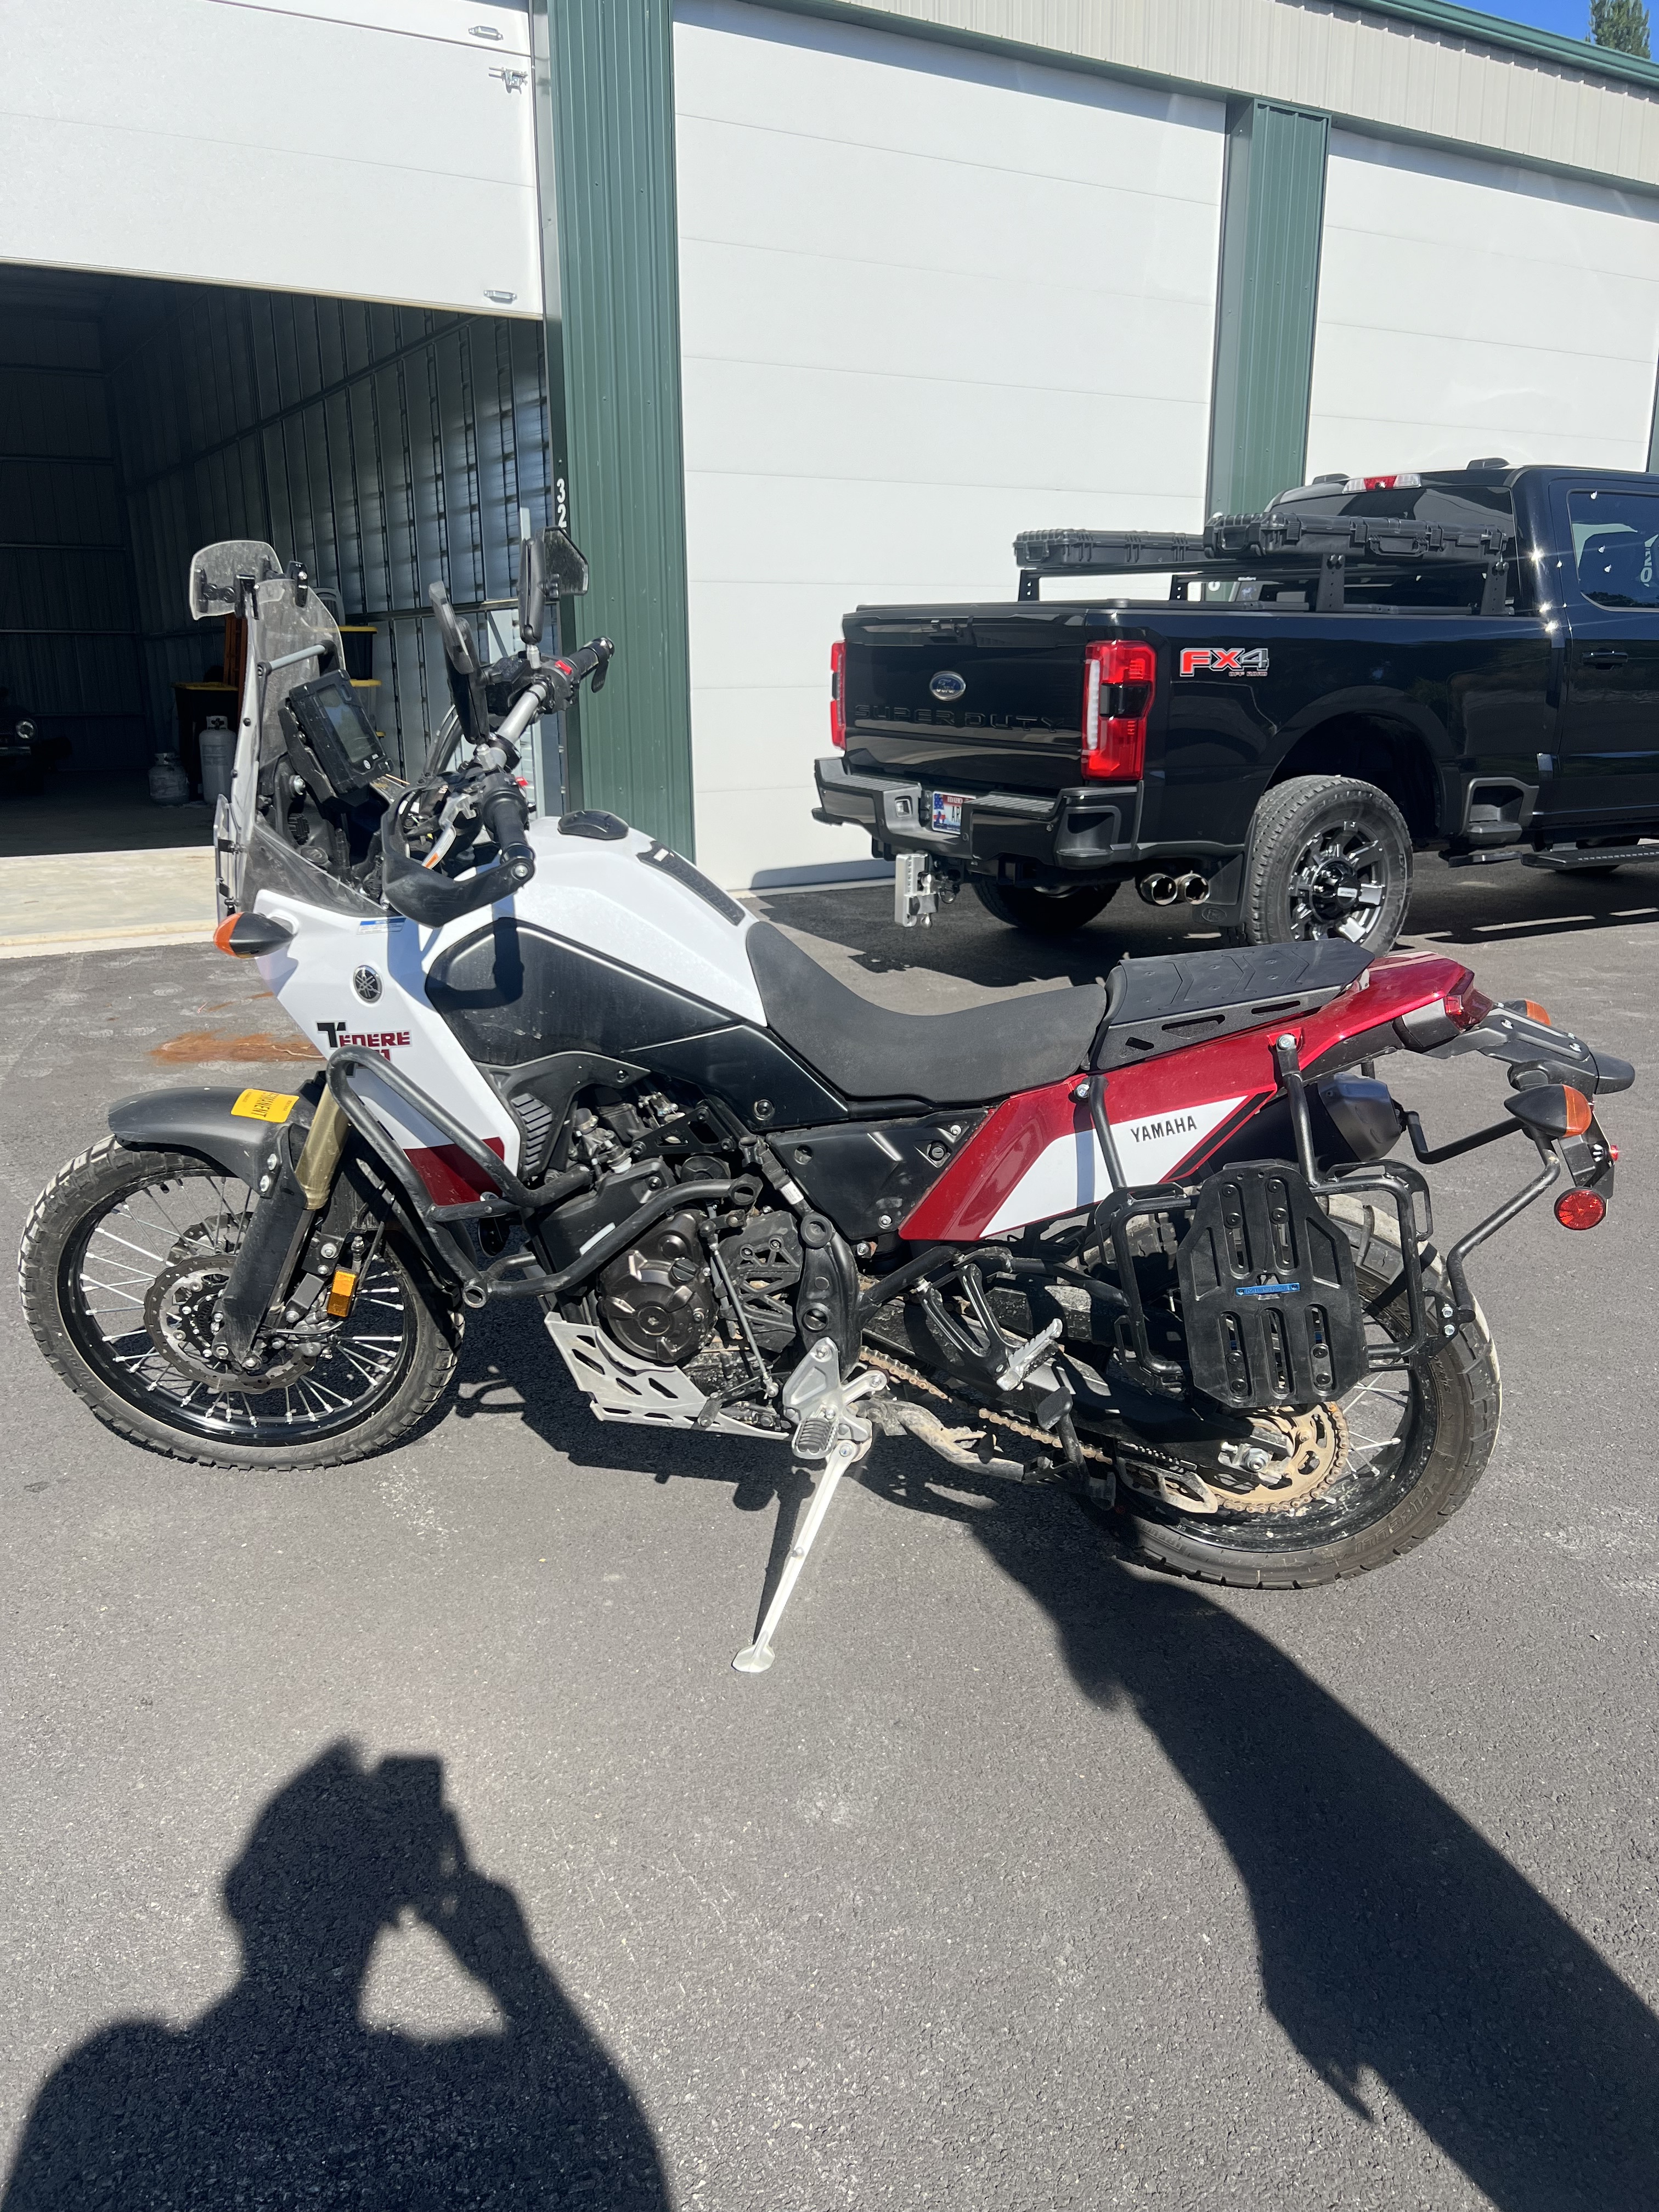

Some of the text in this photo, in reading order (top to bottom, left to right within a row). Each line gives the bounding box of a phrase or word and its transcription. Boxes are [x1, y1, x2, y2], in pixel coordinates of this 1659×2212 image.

[1180, 648, 1269, 676] FX4
[855, 704, 1065, 733] SUPER DUTY
[1130, 1115, 1198, 1143] YAMAHA
[1246, 1285, 1285, 1295] MOSKO
[1355, 1486, 1433, 1554] PIRELLI
